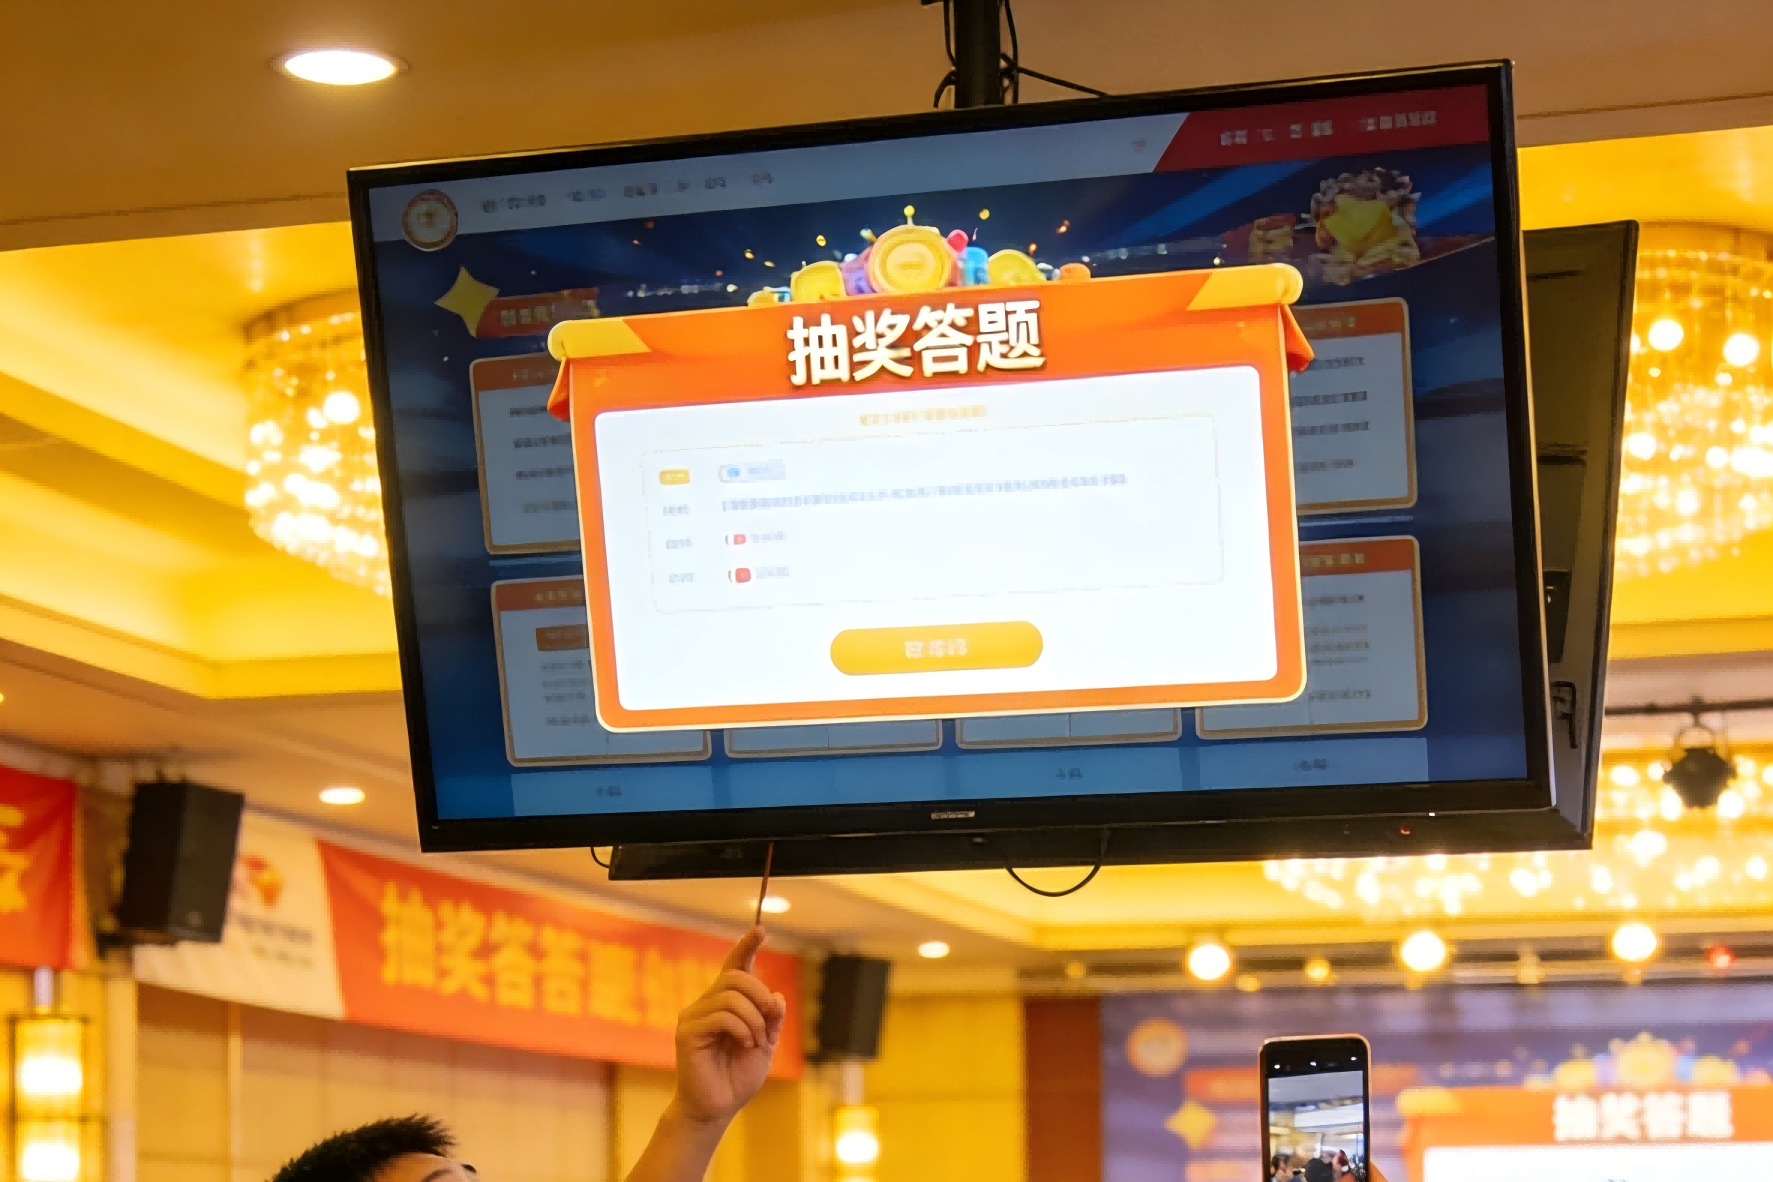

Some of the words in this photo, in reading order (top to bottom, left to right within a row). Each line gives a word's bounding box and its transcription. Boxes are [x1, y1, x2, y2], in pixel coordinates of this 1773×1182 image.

[786, 300, 1046, 386] 抽奖答题
[379, 880, 724, 1032] 抽奖答答题
